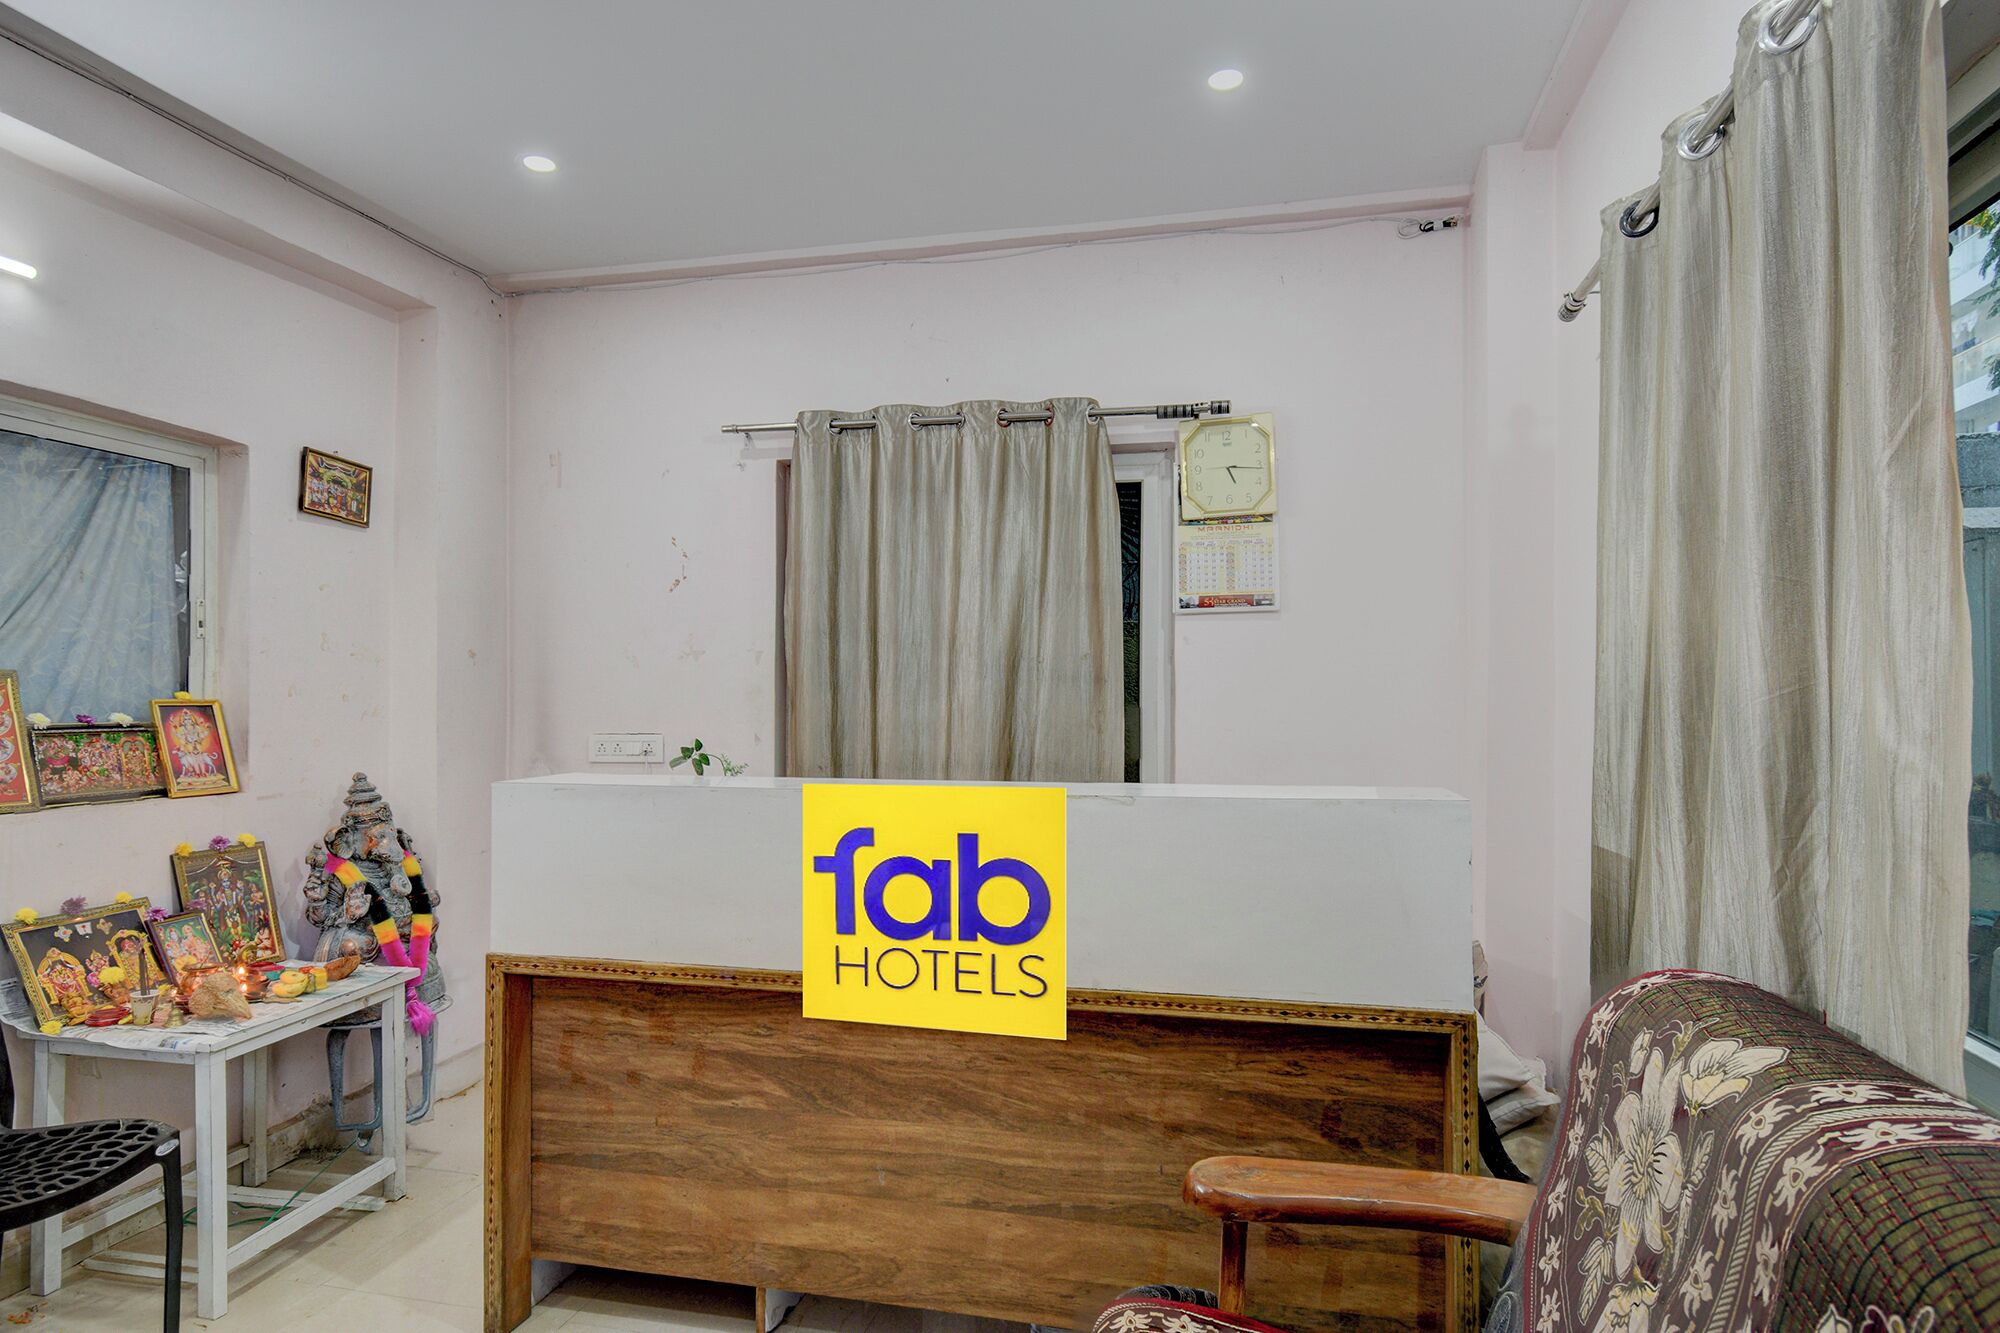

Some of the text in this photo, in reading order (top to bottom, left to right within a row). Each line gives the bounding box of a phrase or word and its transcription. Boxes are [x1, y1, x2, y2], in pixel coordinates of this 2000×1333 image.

[1204, 431, 1210, 442] 11
[1221, 430, 1231, 441] 12
[1255, 443, 1261, 453] 2
[1194, 448, 1204, 459] 10
[1194, 465, 1202, 475] 9
[1195, 481, 1203, 491] 8
[1207, 495, 1213, 505] 7
[1226, 494, 1233, 504] 6
[1246, 493, 1253, 503] 5
[813, 827, 1051, 946] fab
[836, 945, 1048, 998] HOTELS
